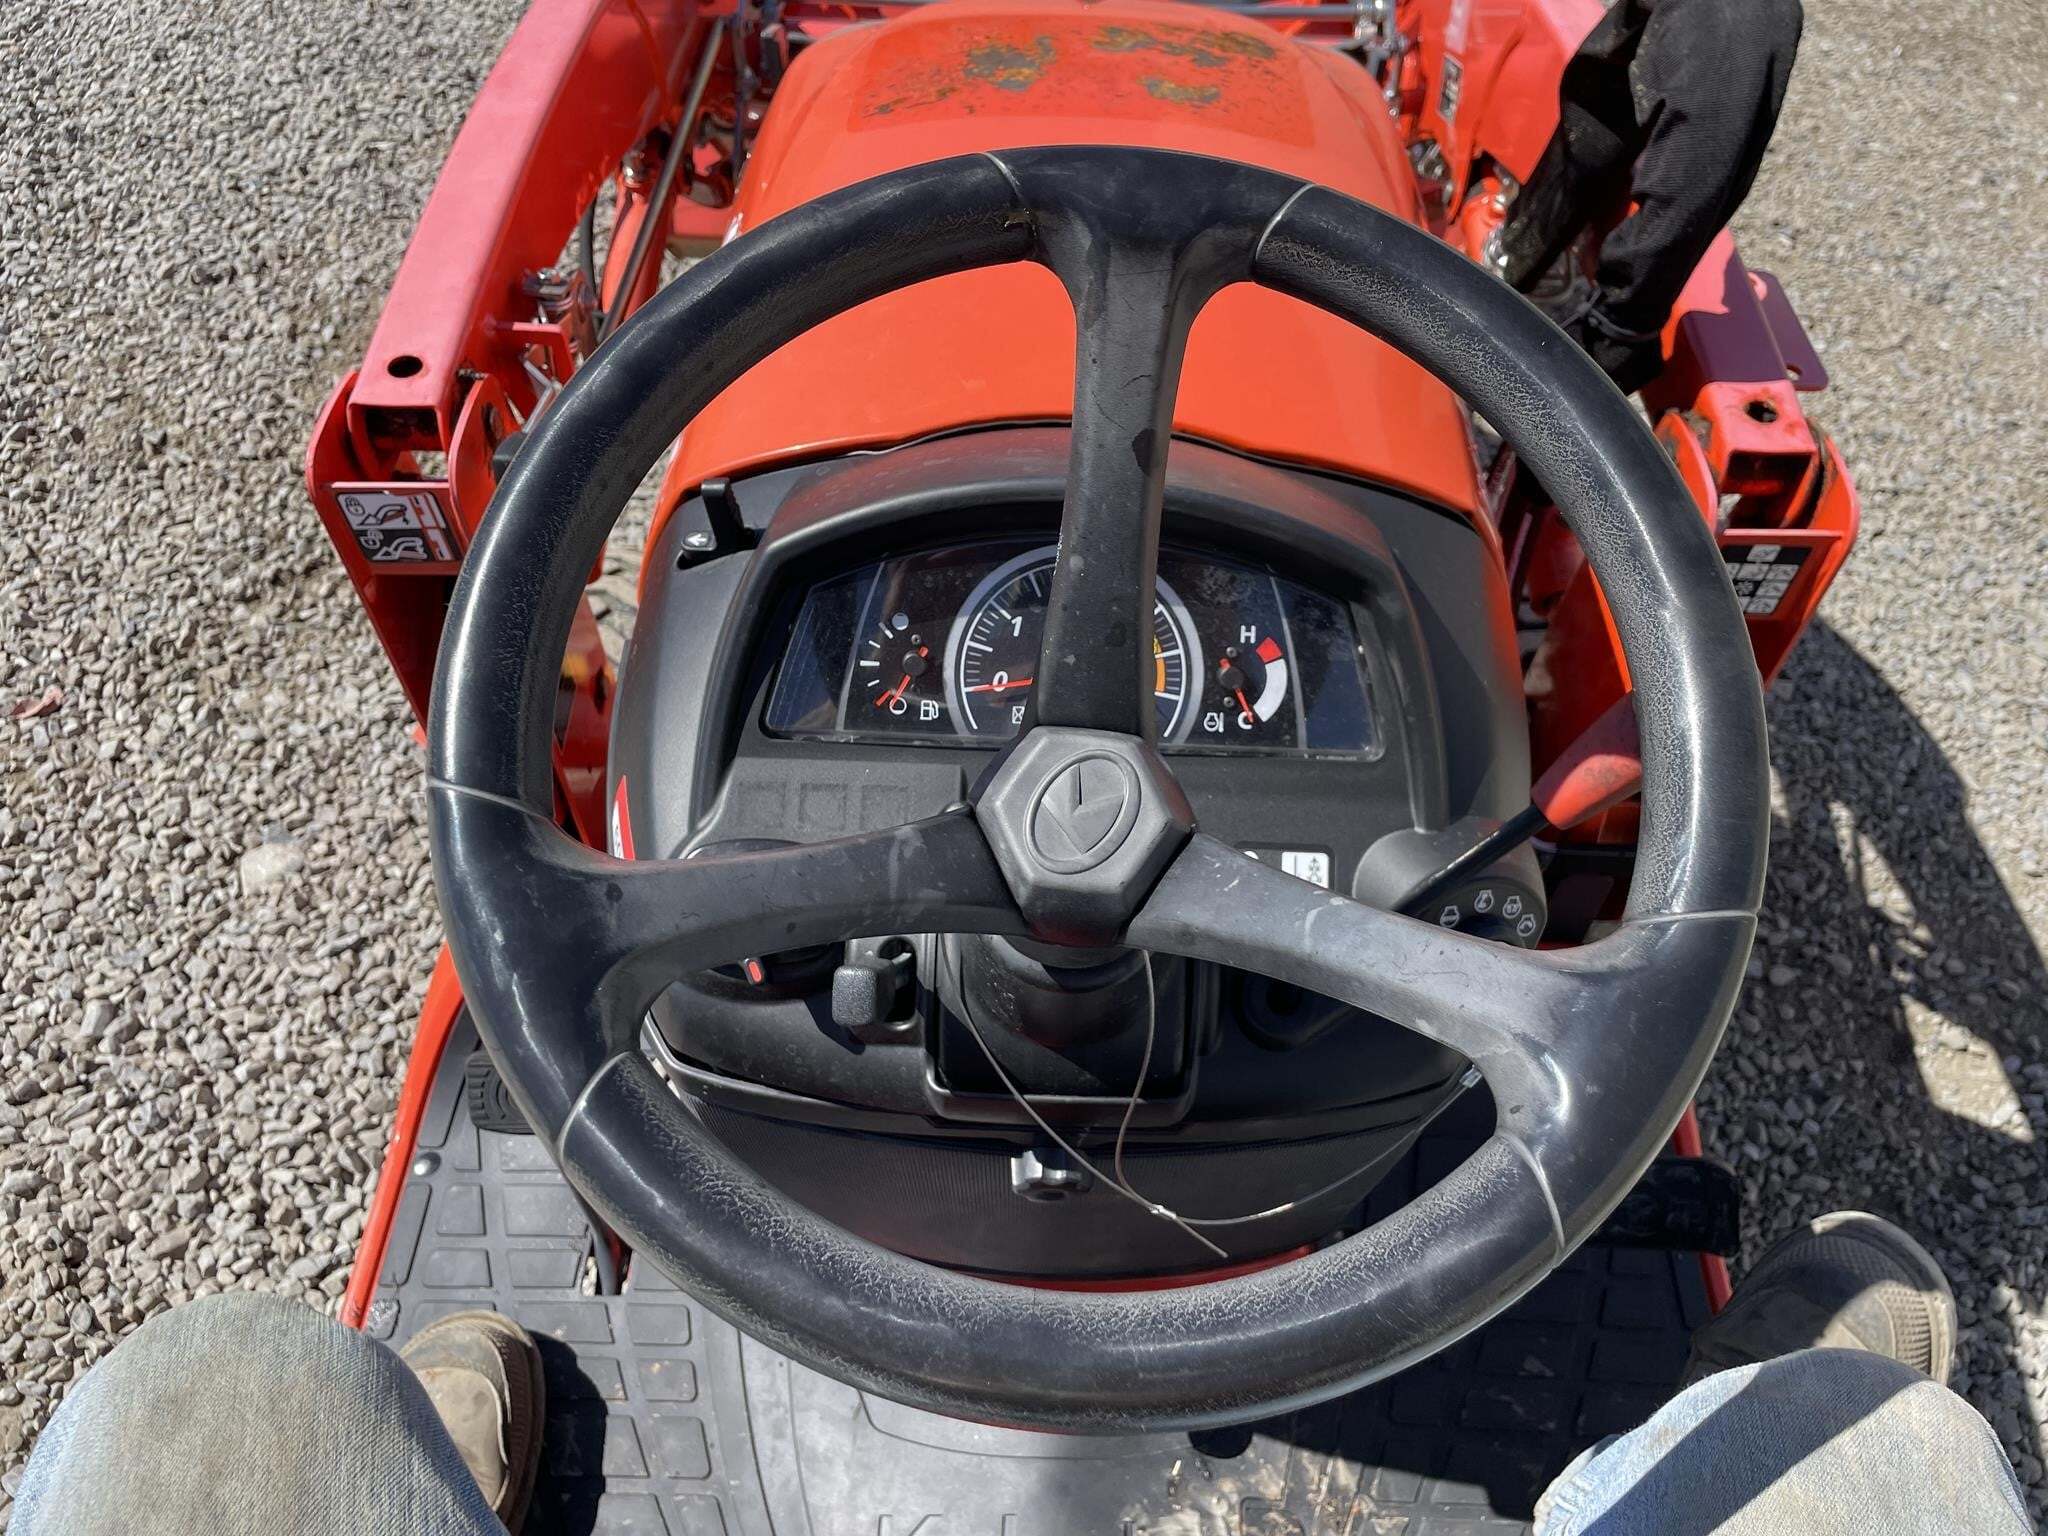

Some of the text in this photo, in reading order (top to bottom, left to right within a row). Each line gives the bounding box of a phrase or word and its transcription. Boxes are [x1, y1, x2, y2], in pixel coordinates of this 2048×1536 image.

[1011, 616, 1022, 637] 1
[1240, 625, 1256, 644] H
[993, 670, 1008, 692] 0
[1237, 711, 1253, 730] C
